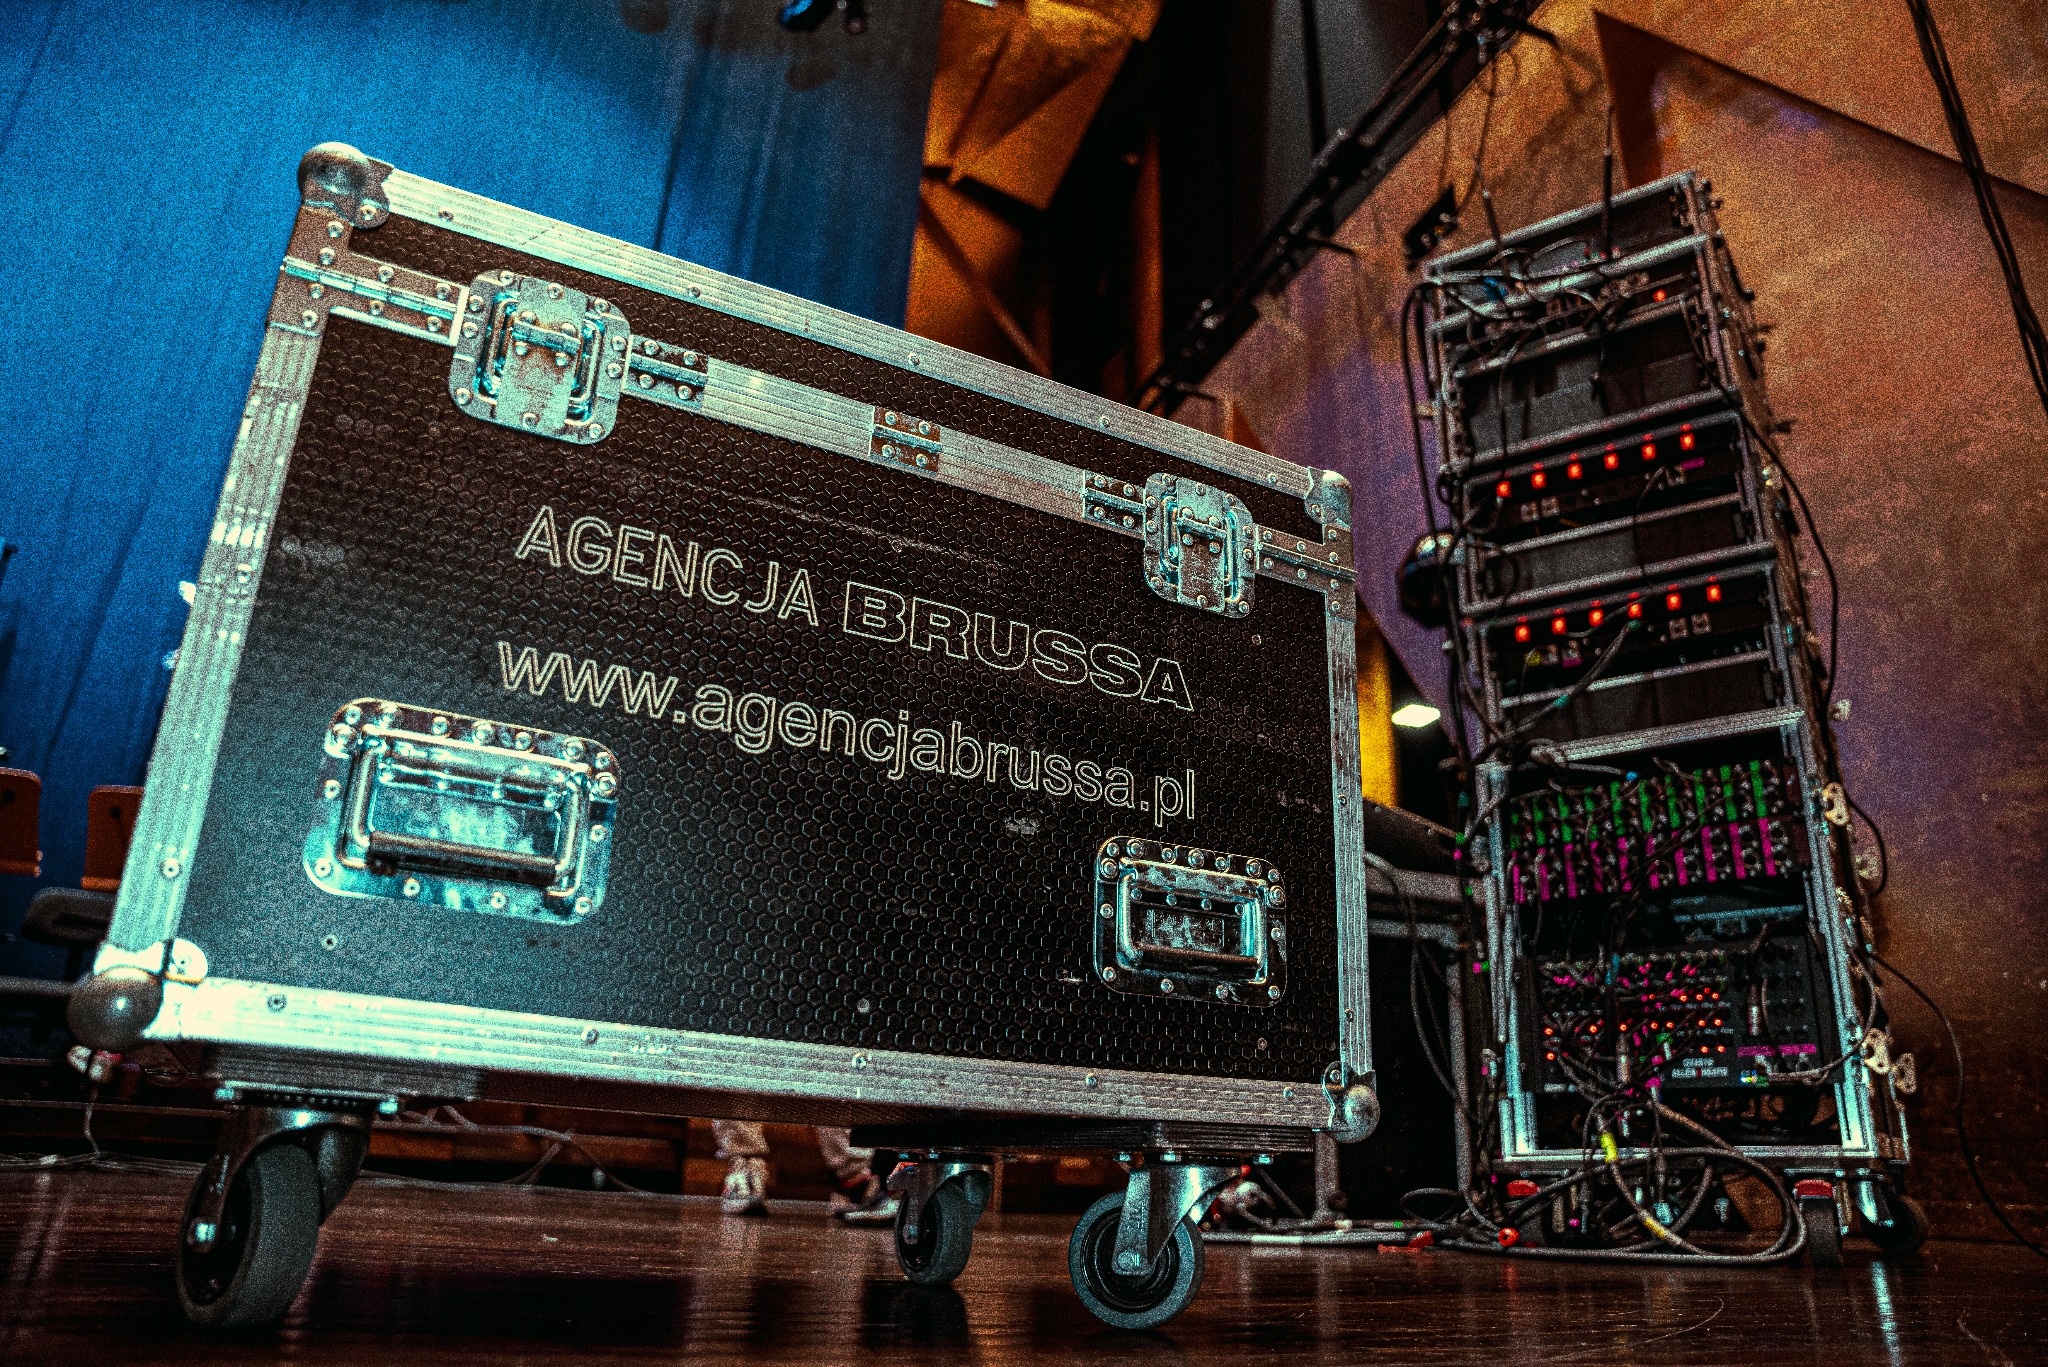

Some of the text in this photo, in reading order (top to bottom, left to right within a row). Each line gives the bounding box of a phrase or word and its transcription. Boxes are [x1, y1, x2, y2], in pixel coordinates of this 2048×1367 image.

[515, 505, 1195, 712] AGENCJA BRUSSA
[498, 641, 1196, 828] www.agencjabrussa.pl
